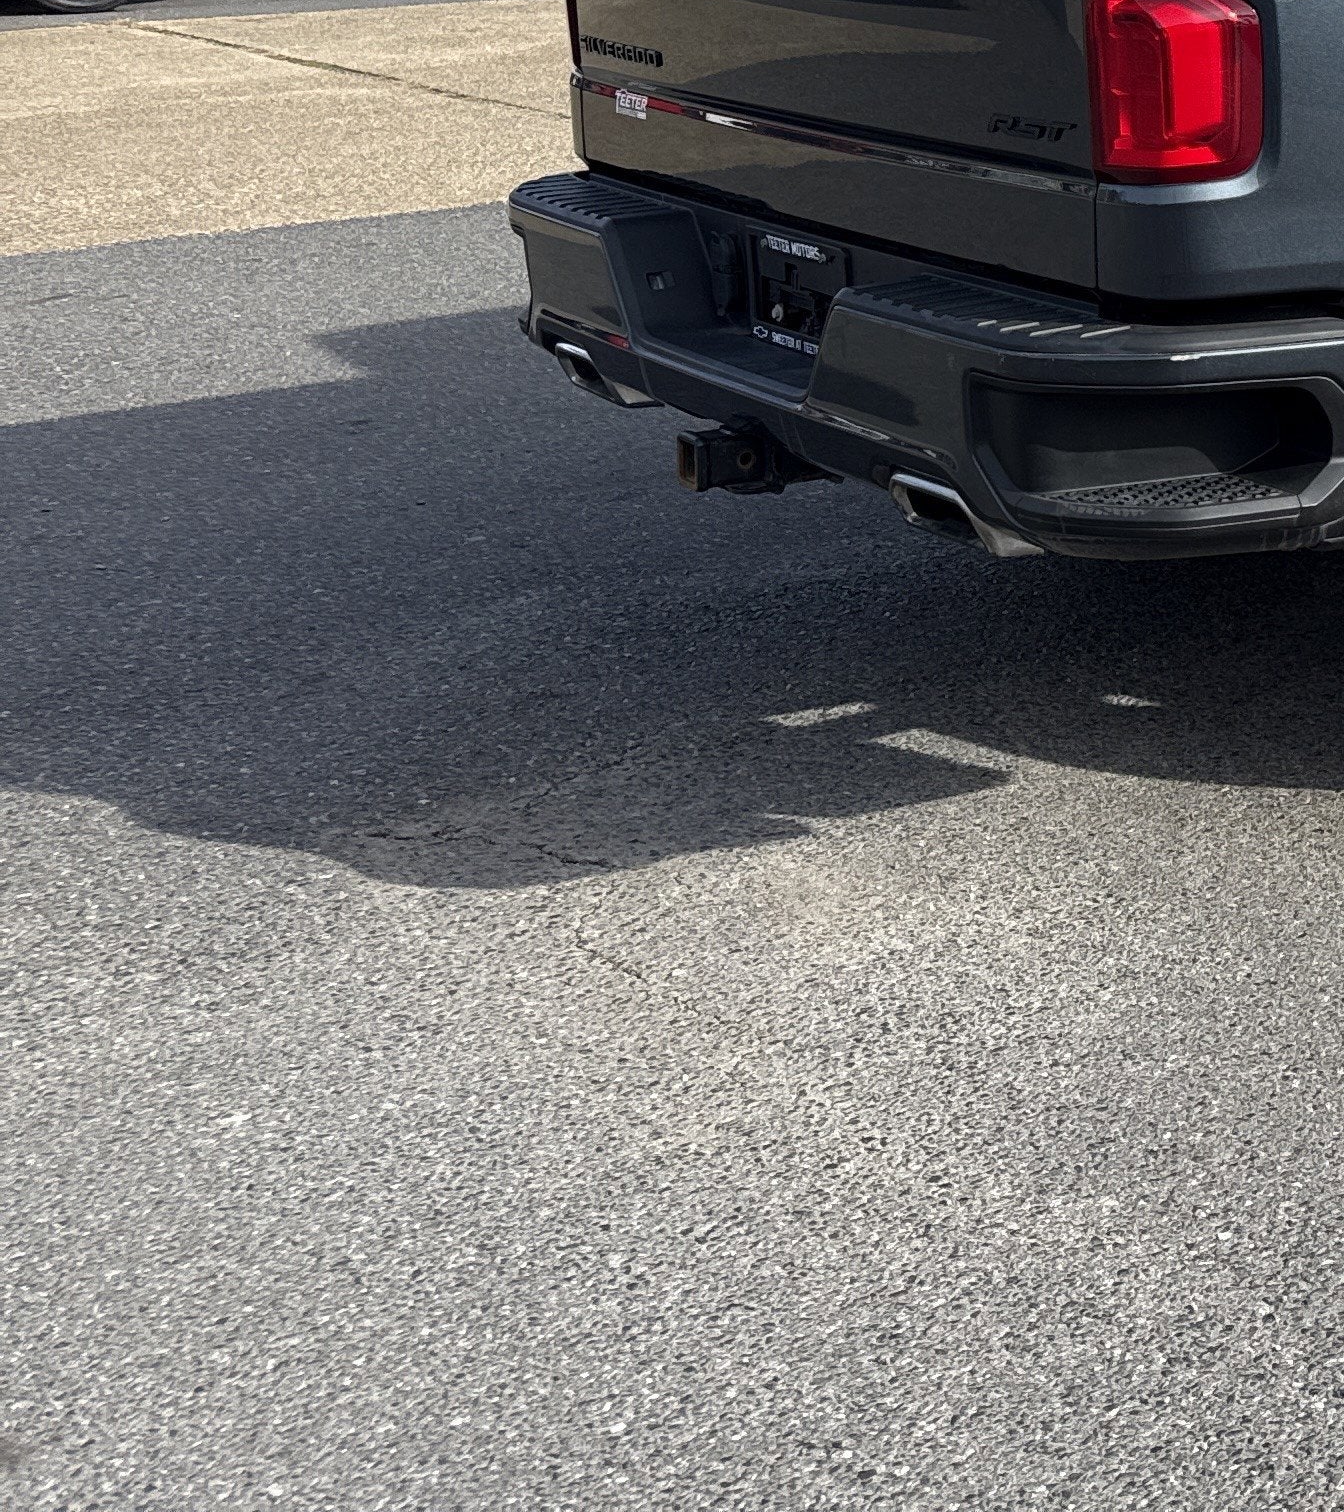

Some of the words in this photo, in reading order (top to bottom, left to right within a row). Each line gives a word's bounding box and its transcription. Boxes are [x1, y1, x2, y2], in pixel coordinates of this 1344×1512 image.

[579, 34, 664, 68] SILVERADO
[615, 92, 648, 112] TEETER
[987, 112, 1078, 142] RST
